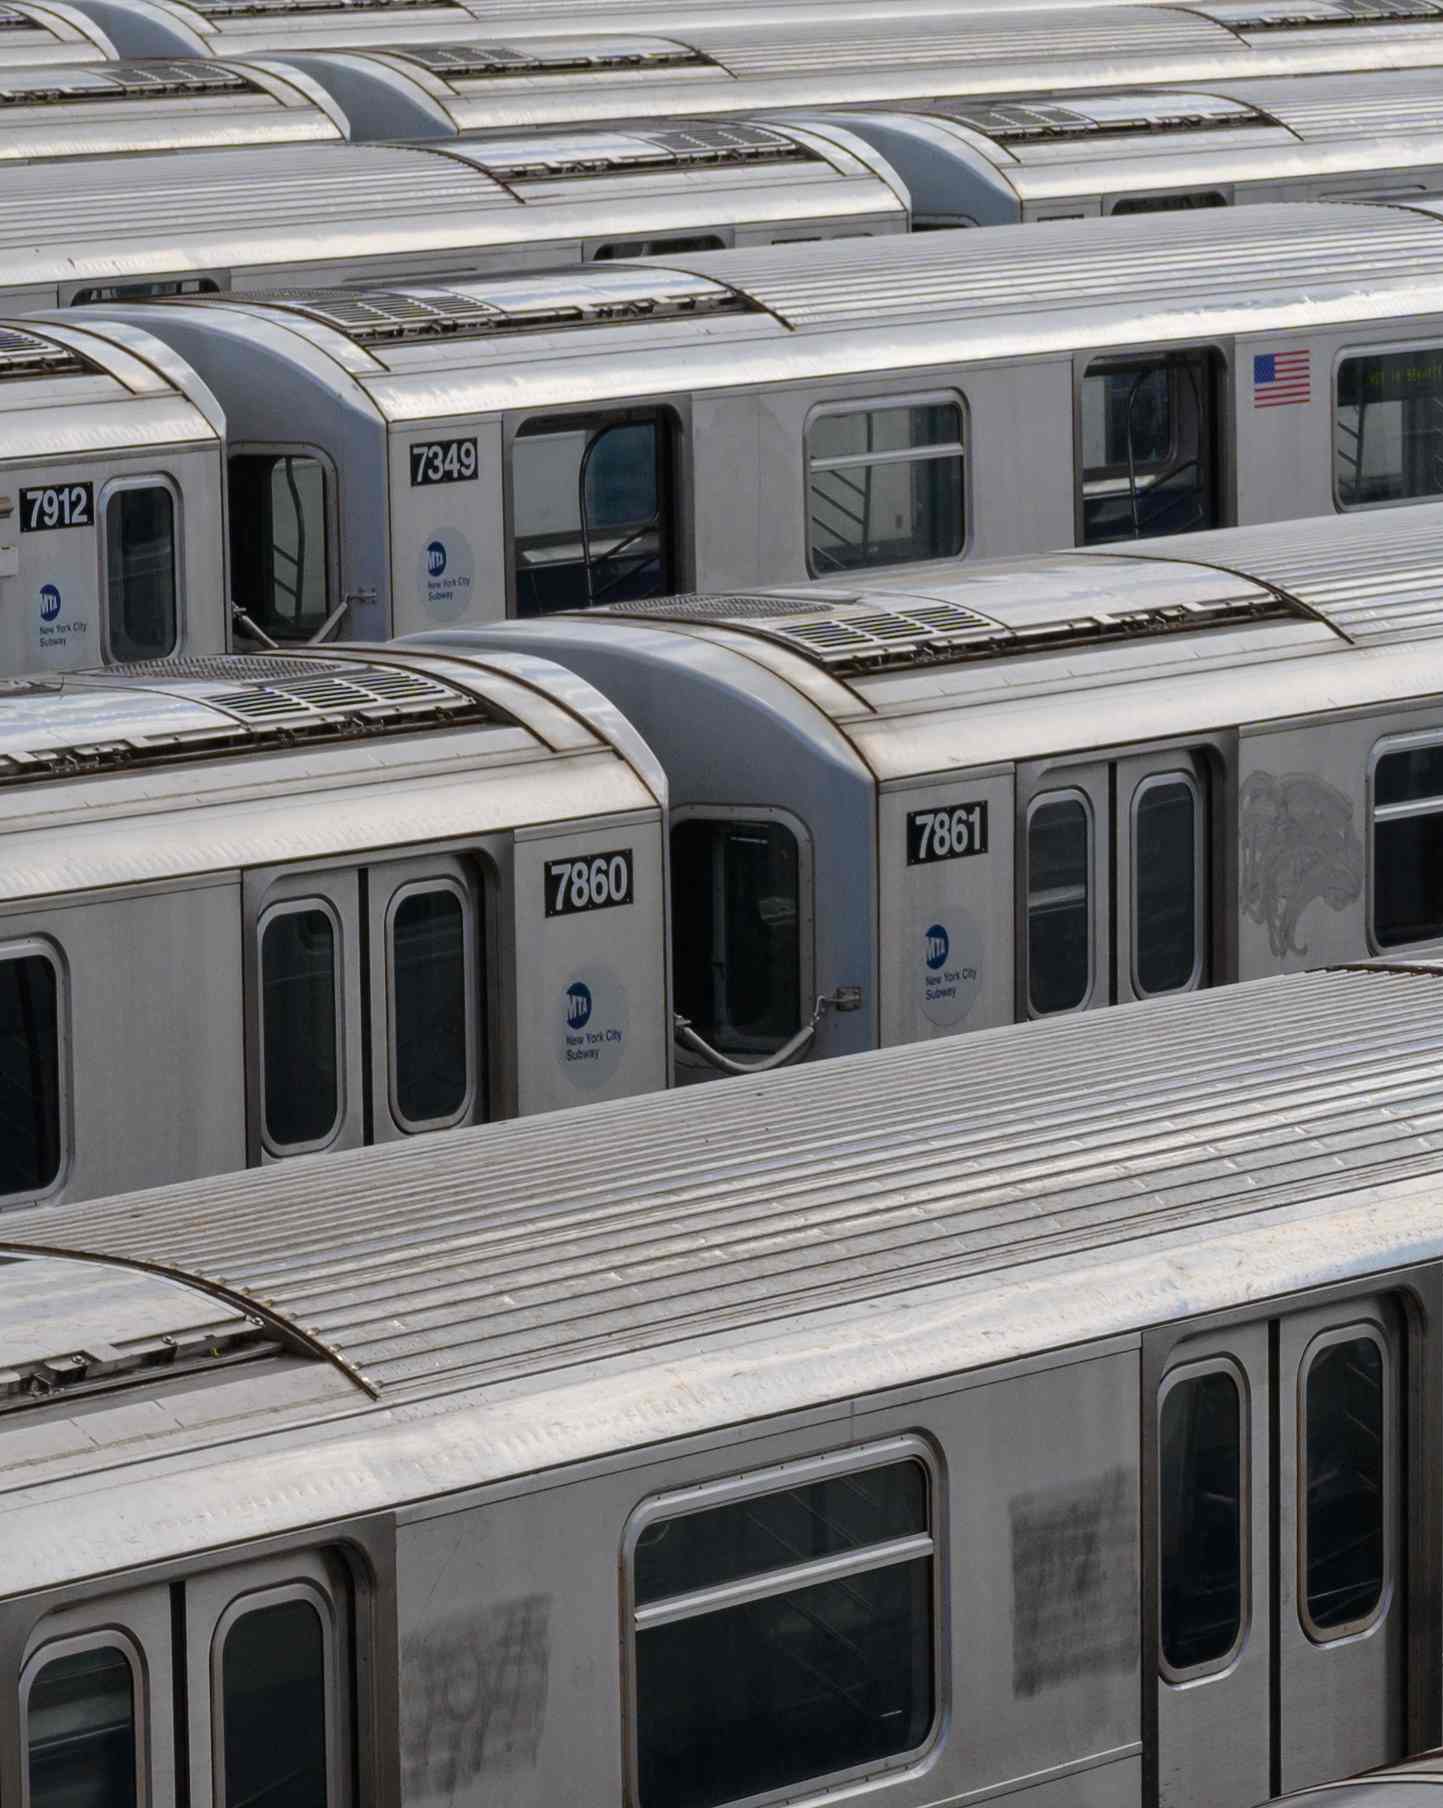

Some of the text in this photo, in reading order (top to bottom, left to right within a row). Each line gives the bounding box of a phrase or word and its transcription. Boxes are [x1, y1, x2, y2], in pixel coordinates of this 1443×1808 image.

[412, 441, 477, 482] 7349
[26, 487, 87, 529] 7912
[916, 803, 983, 859] 7861
[552, 857, 627, 911] 7860
[925, 968, 977, 985] New York City
[926, 987, 956, 1000] Subway
[567, 1029, 621, 1046] New York City
[567, 1047, 599, 1062] Subway
